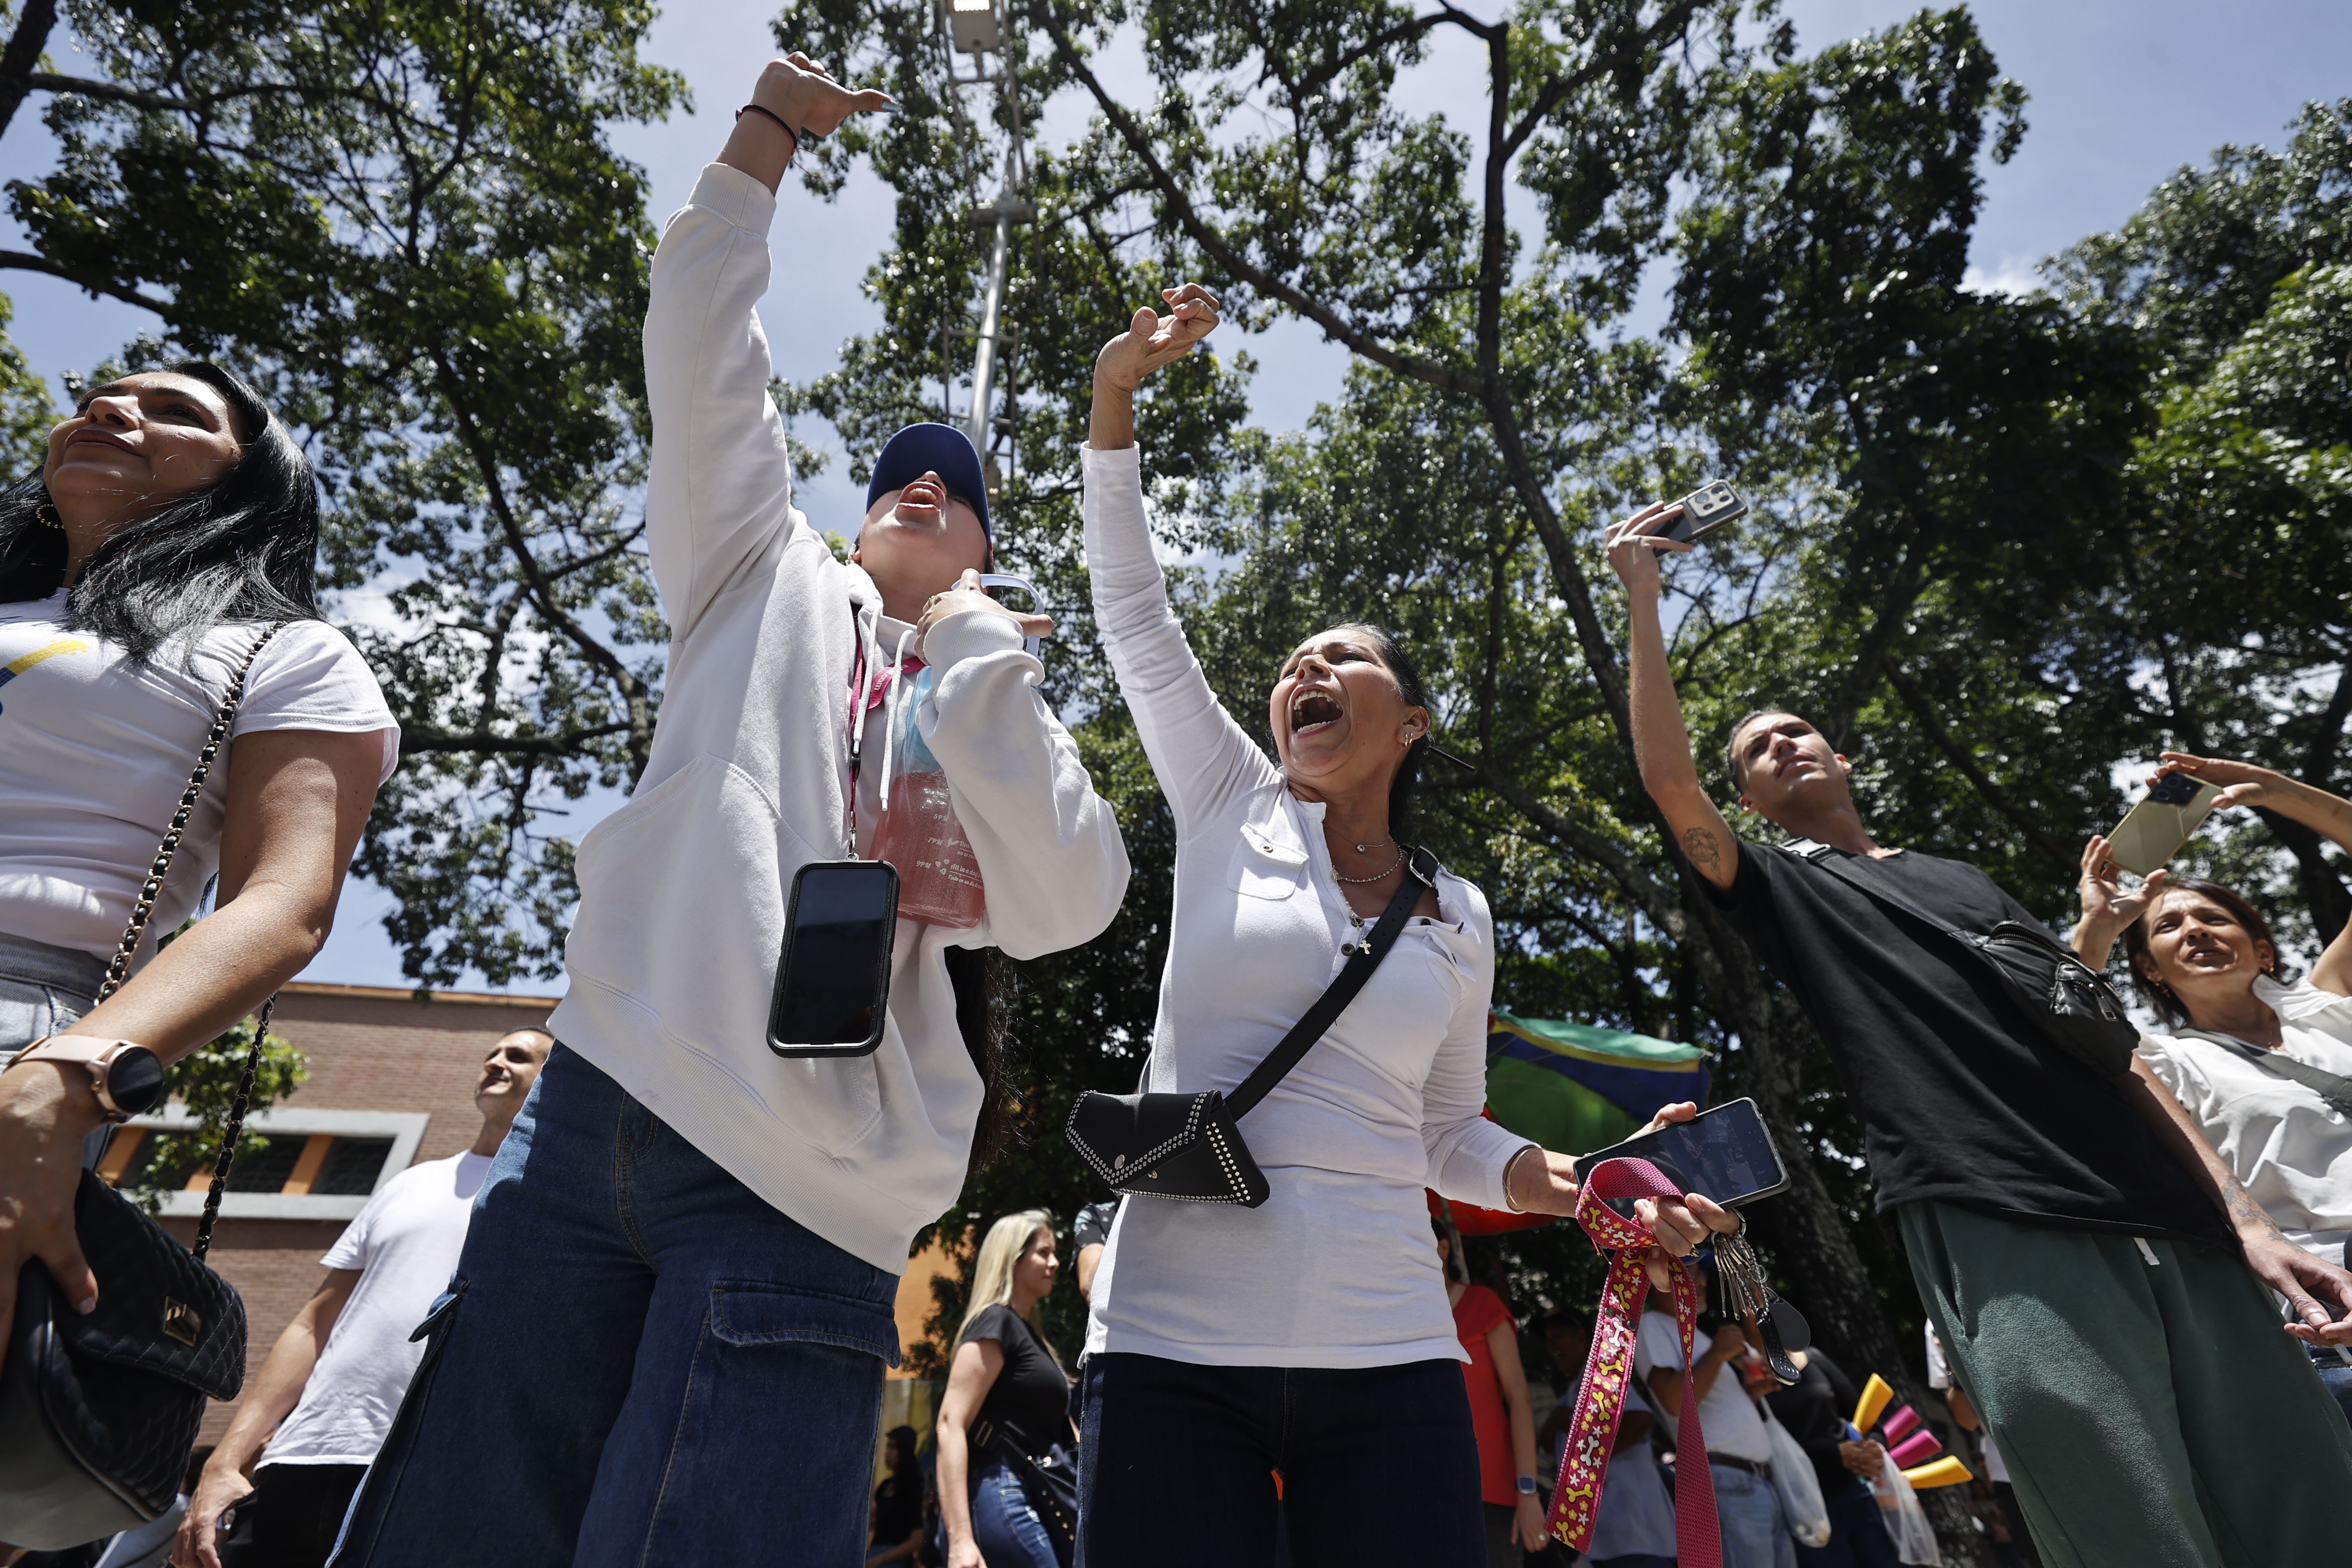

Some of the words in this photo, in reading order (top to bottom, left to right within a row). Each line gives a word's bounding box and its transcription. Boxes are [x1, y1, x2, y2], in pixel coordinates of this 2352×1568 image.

[928, 837, 943, 845] 7PM
[959, 840, 970, 848] Don
[916, 860, 931, 869] 9PM
